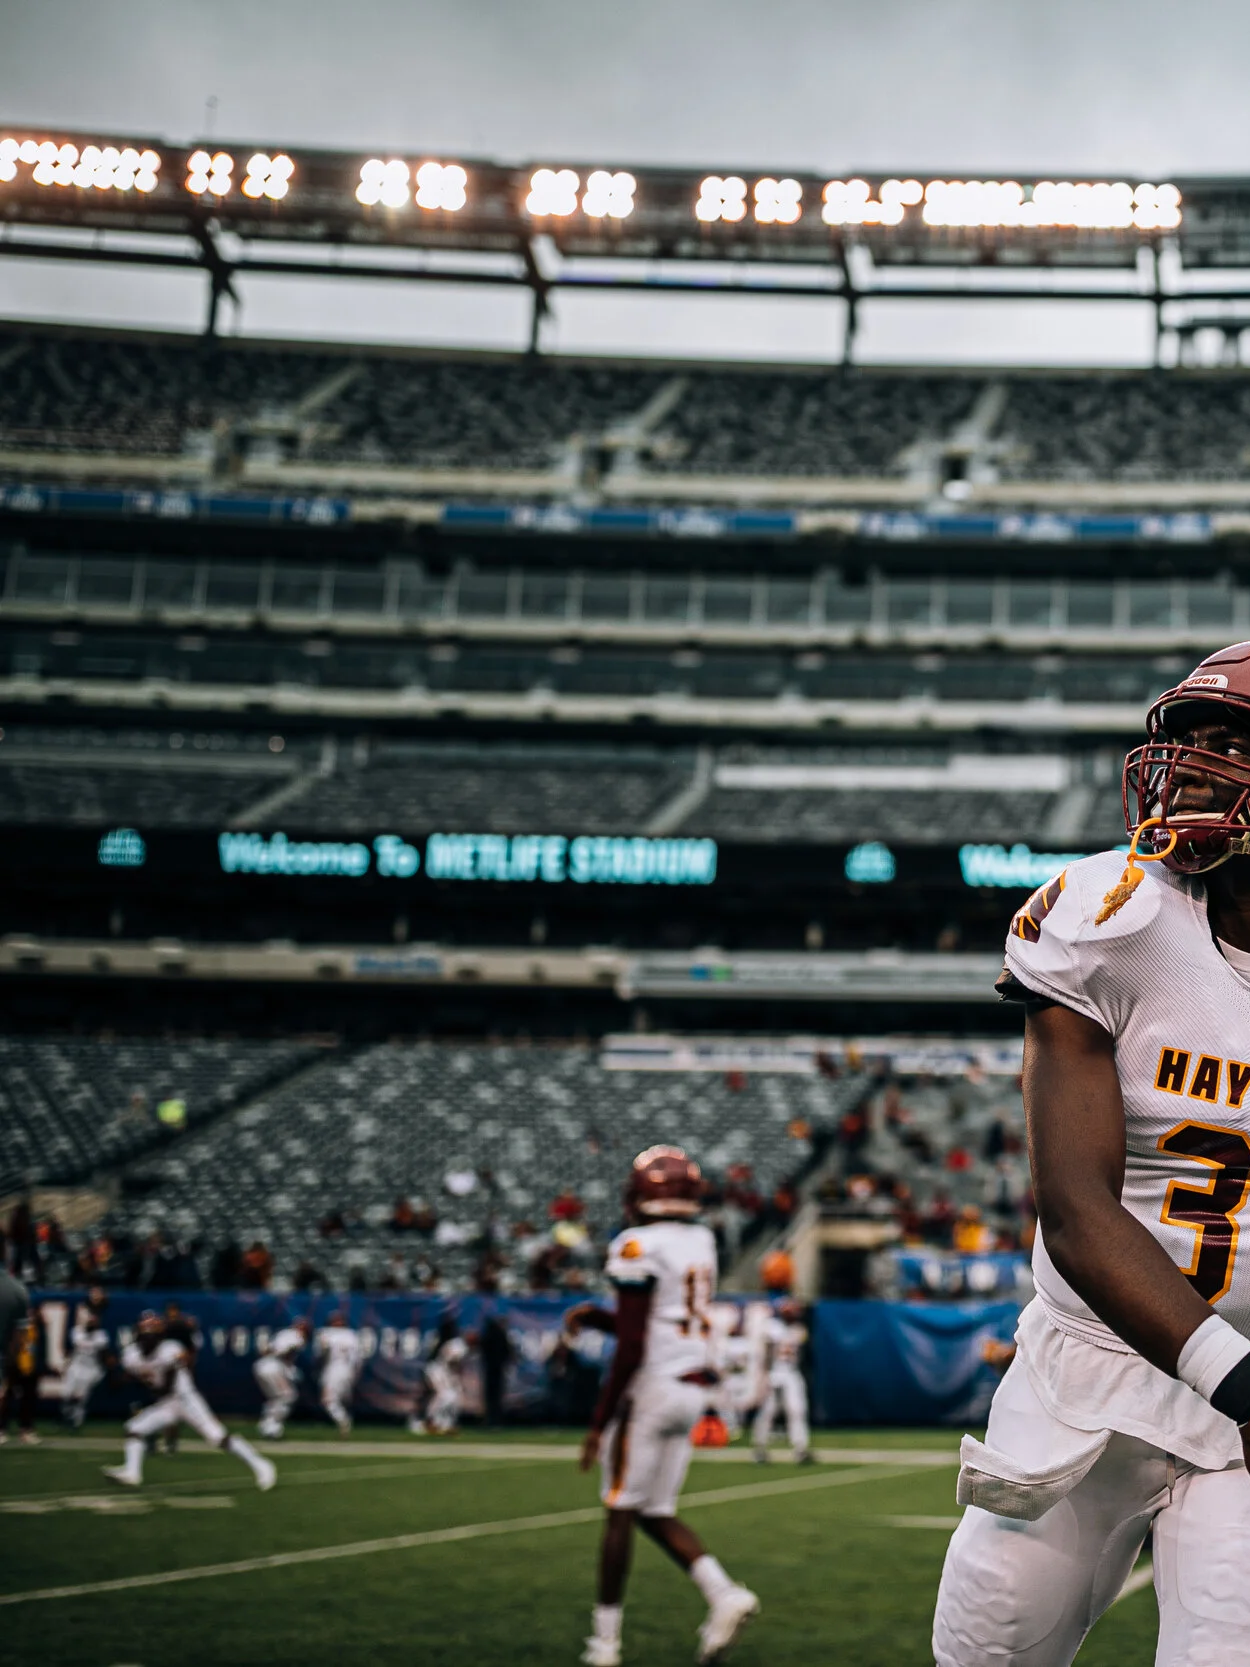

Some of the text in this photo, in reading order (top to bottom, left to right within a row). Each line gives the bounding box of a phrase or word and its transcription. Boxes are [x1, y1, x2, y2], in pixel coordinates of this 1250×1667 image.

[218, 832, 717, 885] Welcome To METLIFE STADIUM
